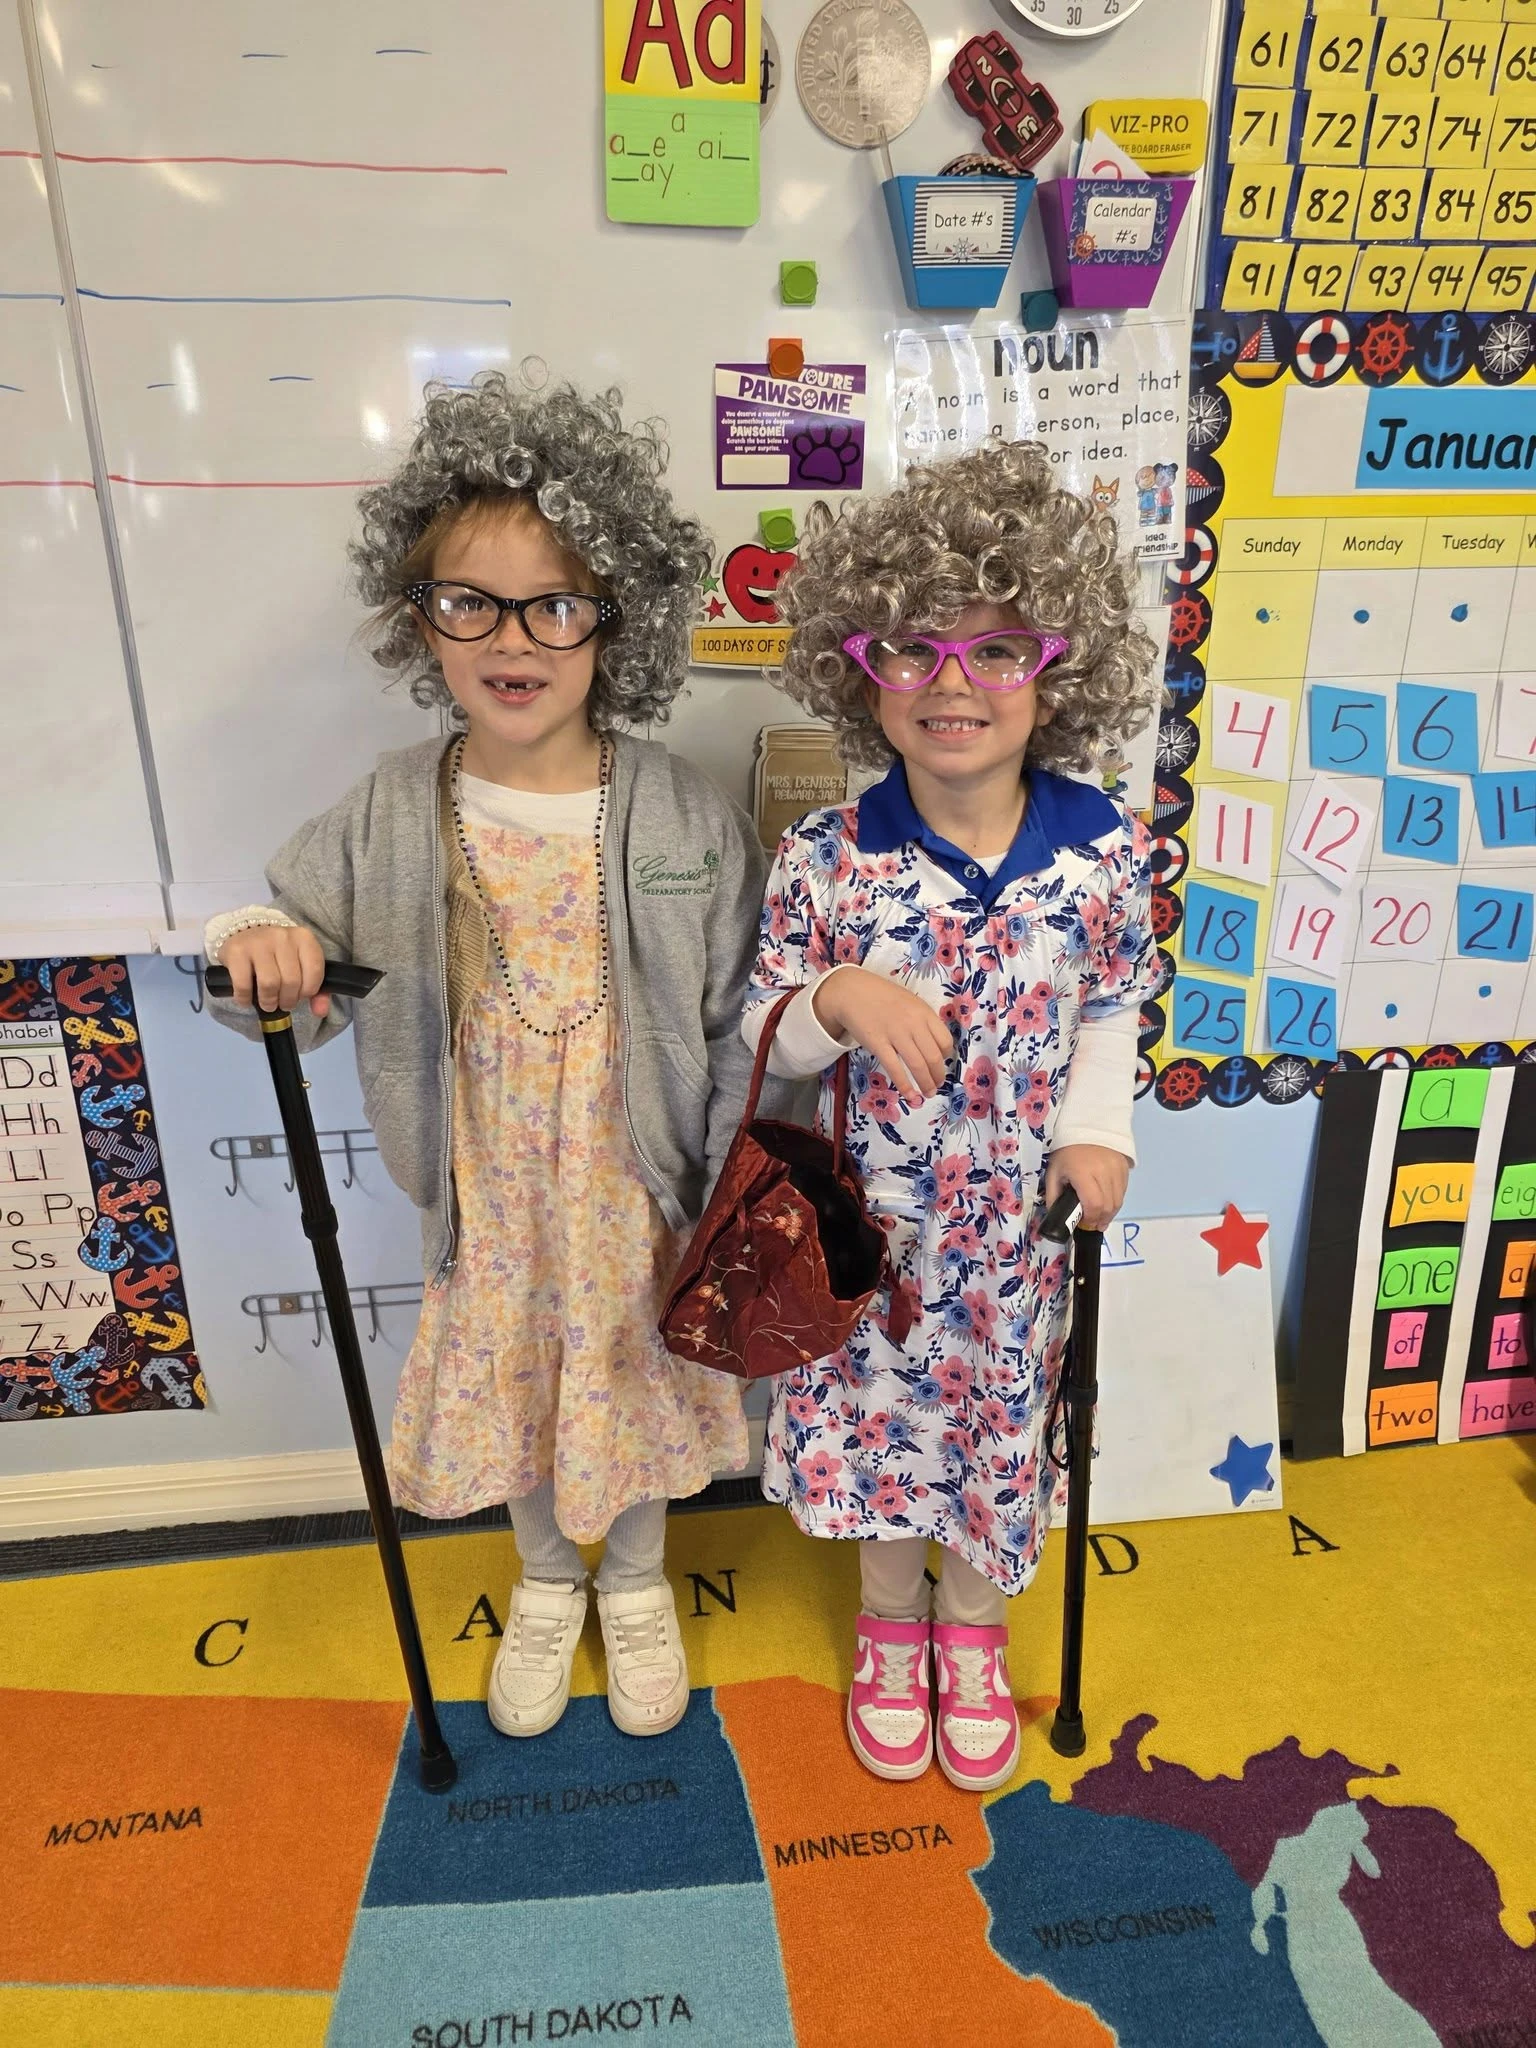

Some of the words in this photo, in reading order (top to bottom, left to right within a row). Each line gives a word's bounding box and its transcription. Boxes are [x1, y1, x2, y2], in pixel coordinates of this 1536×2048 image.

[1066, 7, 1082, 26] 30
[1250, 31, 1288, 68] 61
[1319, 36, 1363, 74] 62
[1386, 42, 1429, 78] 63
[1444, 44, 1486, 80] 64
[671, 112, 685, 133] a
[1110, 115, 1189, 134] VIZ-PRO
[1239, 111, 1279, 147] 71
[1312, 113, 1357, 148] 72
[1377, 115, 1421, 149] 73
[1438, 116, 1481, 152] 74
[934, 213, 967, 229] Date
[1093, 204, 1152, 219] Calendar
[1239, 185, 1276, 220] 81
[1306, 188, 1349, 224] 82
[1370, 189, 1412, 223] 83
[1435, 189, 1475, 223] 84
[1493, 190, 1536, 224] 85
[1242, 263, 1275, 296] 91
[1303, 264, 1342, 297] 92
[1368, 265, 1406, 297] 93
[1427, 265, 1464, 297] 94
[1487, 266, 1528, 297] 95
[993, 331, 1099, 377] noun
[738, 375, 853, 415] PAWSOME
[1003, 387, 1019, 403] is
[1038, 386, 1049, 401] a
[1069, 374, 1119, 398] word
[1138, 371, 1182, 392] that
[1122, 407, 1181, 429] place,
[1051, 451, 1072, 465] or
[1082, 441, 1128, 461] idea.
[1242, 537, 1301, 557] Sunday
[1342, 535, 1404, 554] Monday
[1441, 534, 1505, 553] Tuesday
[702, 640, 721, 652] 100
[724, 640, 754, 652] DAYS
[757, 640, 775, 653] OF
[1227, 701, 1275, 768] 4
[1329, 703, 1375, 763] 5
[1412, 695, 1454, 762] 6
[766, 775, 792, 788] MRS.
[774, 789, 815, 800] REWARD
[817, 789, 837, 800] JAR
[1216, 804, 1253, 865] 11
[1302, 797, 1360, 874] 12
[1396, 793, 1444, 847] 13
[633, 855, 702, 889] Genesis
[1196, 904, 1247, 962] 18
[1288, 904, 1336, 961] 19
[1370, 897, 1431, 946] 20
[1463, 899, 1524, 951] 21
[0, 1024, 54, 1040] habet
[1181, 990, 1246, 1045] 25
[1275, 987, 1332, 1048] 26
[0, 1054, 57, 1089] Dd
[1419, 1077, 1456, 1123] a
[0, 1102, 61, 1136] Hh
[44, 1193, 95, 1237] Pp
[1401, 1183, 1464, 1222] you
[12, 1240, 56, 1270] Ss
[22, 1280, 107, 1311] Ww
[1382, 1259, 1454, 1298] one
[20, 1323, 69, 1352] Zz
[1393, 1323, 1423, 1355] of
[1493, 1327, 1522, 1357] to
[1371, 1400, 1434, 1431] two
[1471, 1394, 1535, 1424] have
[447, 1793, 551, 1824] NORTH
[560, 1778, 681, 1813] DAKOTA
[44, 1806, 204, 1849] MONTANA
[773, 1823, 954, 1869] MINNESOTA
[1031, 1902, 1218, 1953] WISCONSIN
[411, 2010, 534, 2048] SOUTH
[546, 1993, 693, 2041] DAKOTA
